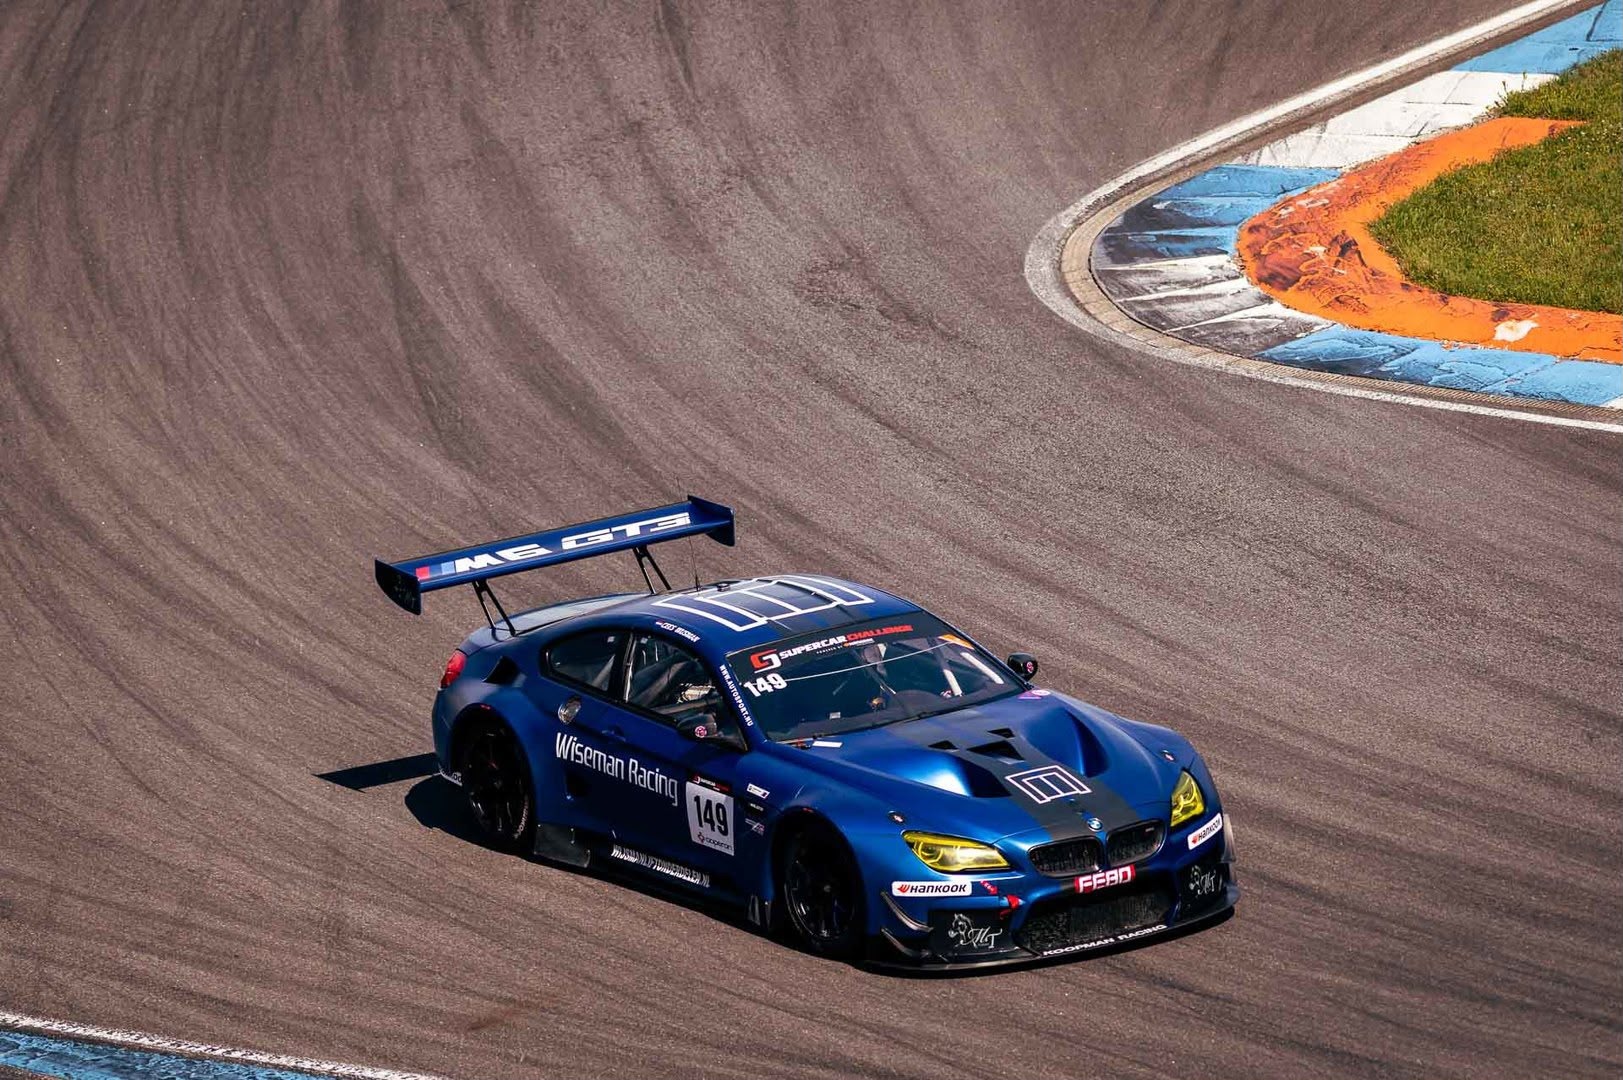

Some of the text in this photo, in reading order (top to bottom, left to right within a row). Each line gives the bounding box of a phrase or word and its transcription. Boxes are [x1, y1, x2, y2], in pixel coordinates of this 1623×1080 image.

[454, 511, 691, 573] M6 GT3
[719, 664, 754, 727] WWW.AUTOSPORT.NU
[743, 673, 787, 697] 149
[555, 732, 678, 806] Wiseman Racing
[693, 795, 729, 836] 149
[1043, 924, 1168, 956] KOOPMAN RACING
